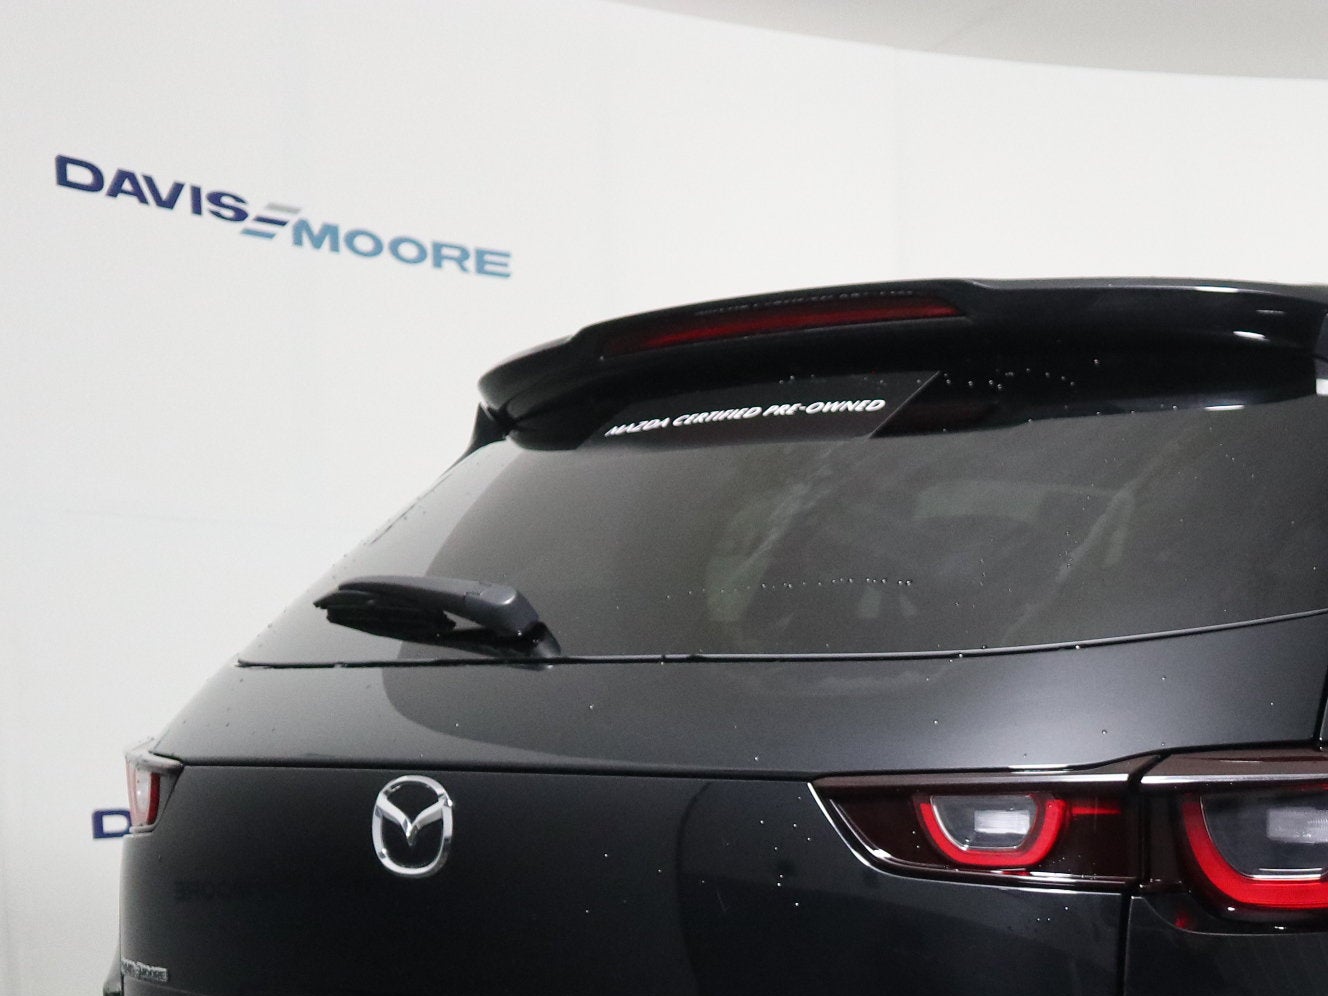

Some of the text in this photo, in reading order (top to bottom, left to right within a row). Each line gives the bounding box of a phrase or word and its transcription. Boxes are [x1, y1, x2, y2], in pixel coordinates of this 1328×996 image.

[54, 153, 512, 279] DAVIS MOORE
[604, 399, 886, 437] MAZDA CERTIFIED PRE-OWNED
